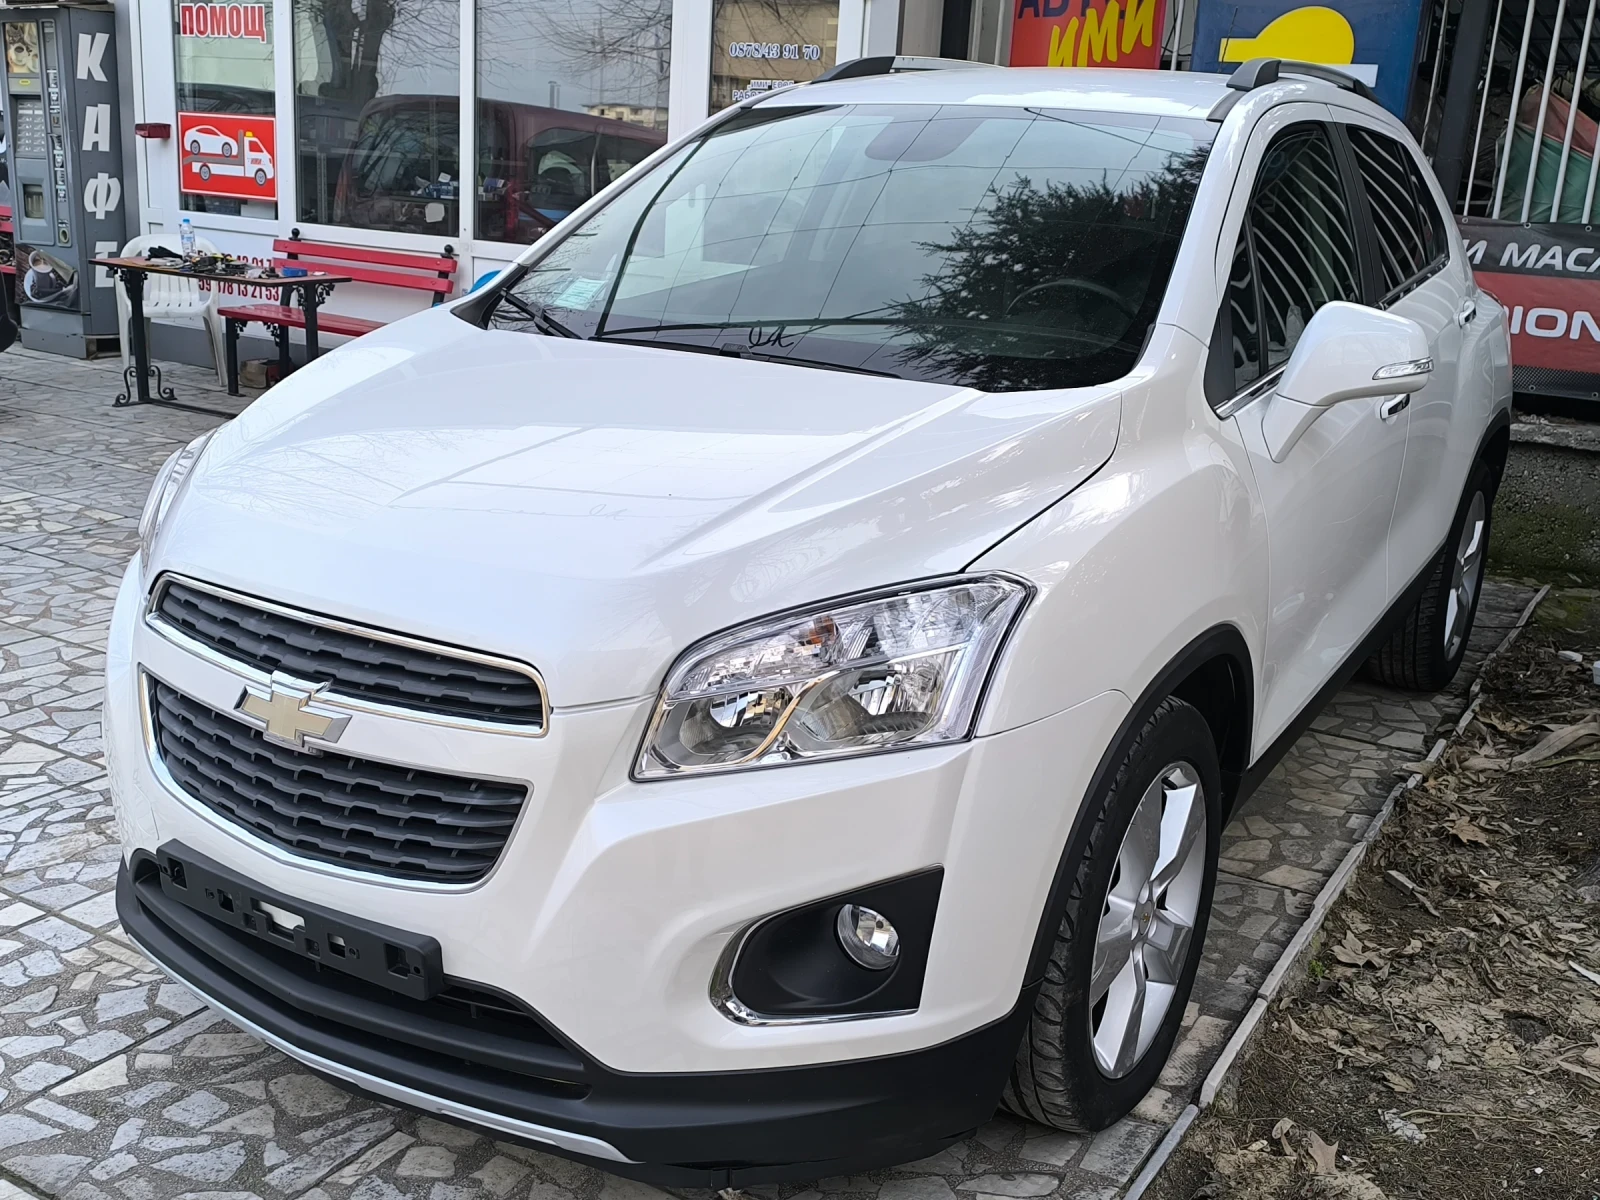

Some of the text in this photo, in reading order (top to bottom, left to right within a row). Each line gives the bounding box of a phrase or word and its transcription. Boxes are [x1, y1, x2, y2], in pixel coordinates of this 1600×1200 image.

[181, 4, 267, 43] ПОМОЩ
[1048, 0, 1155, 67] ИМИ
[729, 42, 820, 60] 0878/43 91 70
[77, 32, 121, 288] КАФЕ
[265, 286, 279, 302] 53
[1503, 305, 1600, 342] ION
